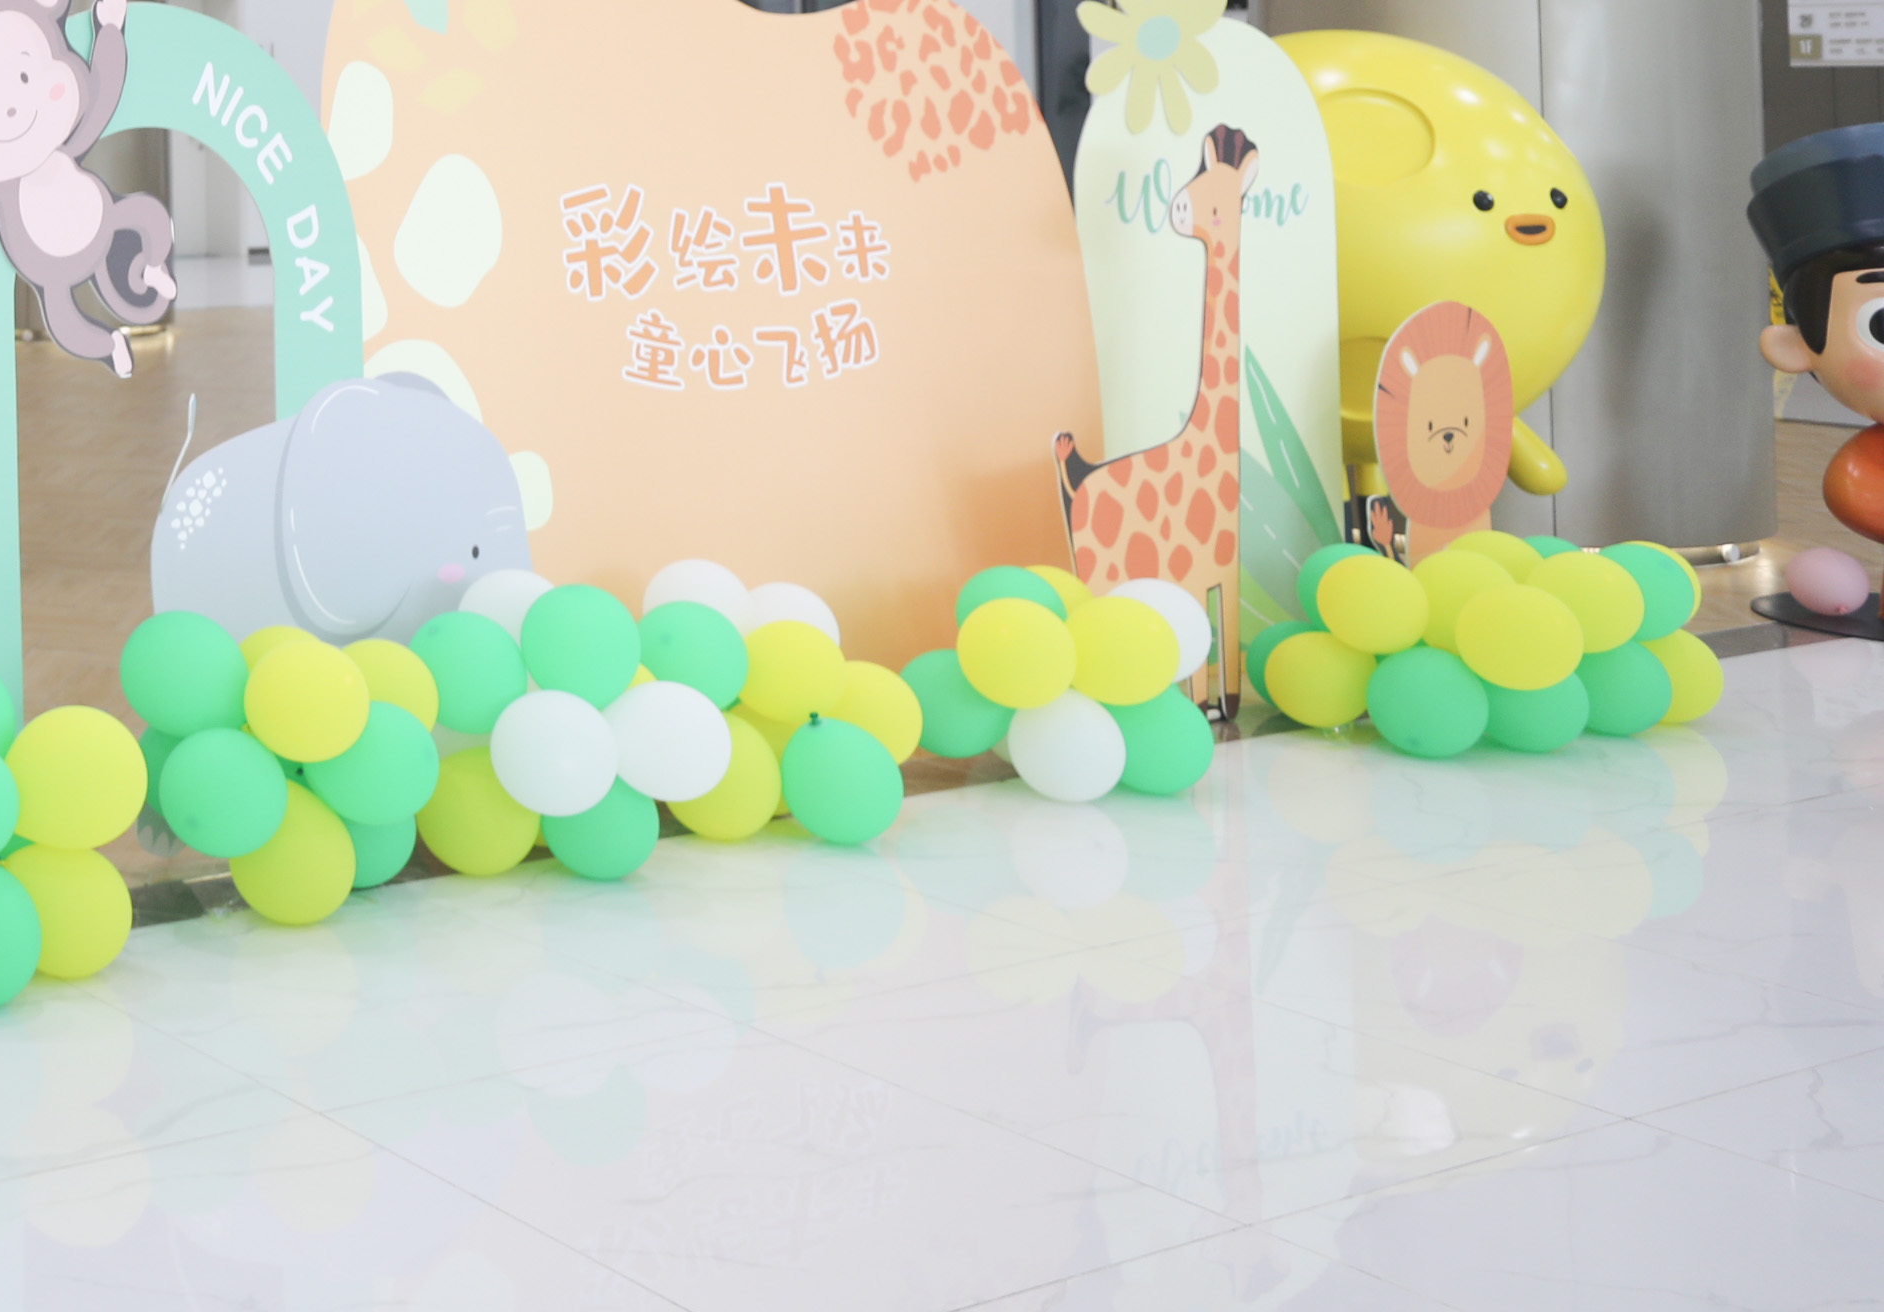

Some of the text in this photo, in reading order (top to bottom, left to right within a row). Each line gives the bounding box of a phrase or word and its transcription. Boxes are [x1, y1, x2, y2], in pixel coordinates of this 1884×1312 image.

[191, 60, 334, 333] NICE DAY
[561, 183, 892, 300] 彩绘未来
[622, 299, 880, 390] 童心飞扬
